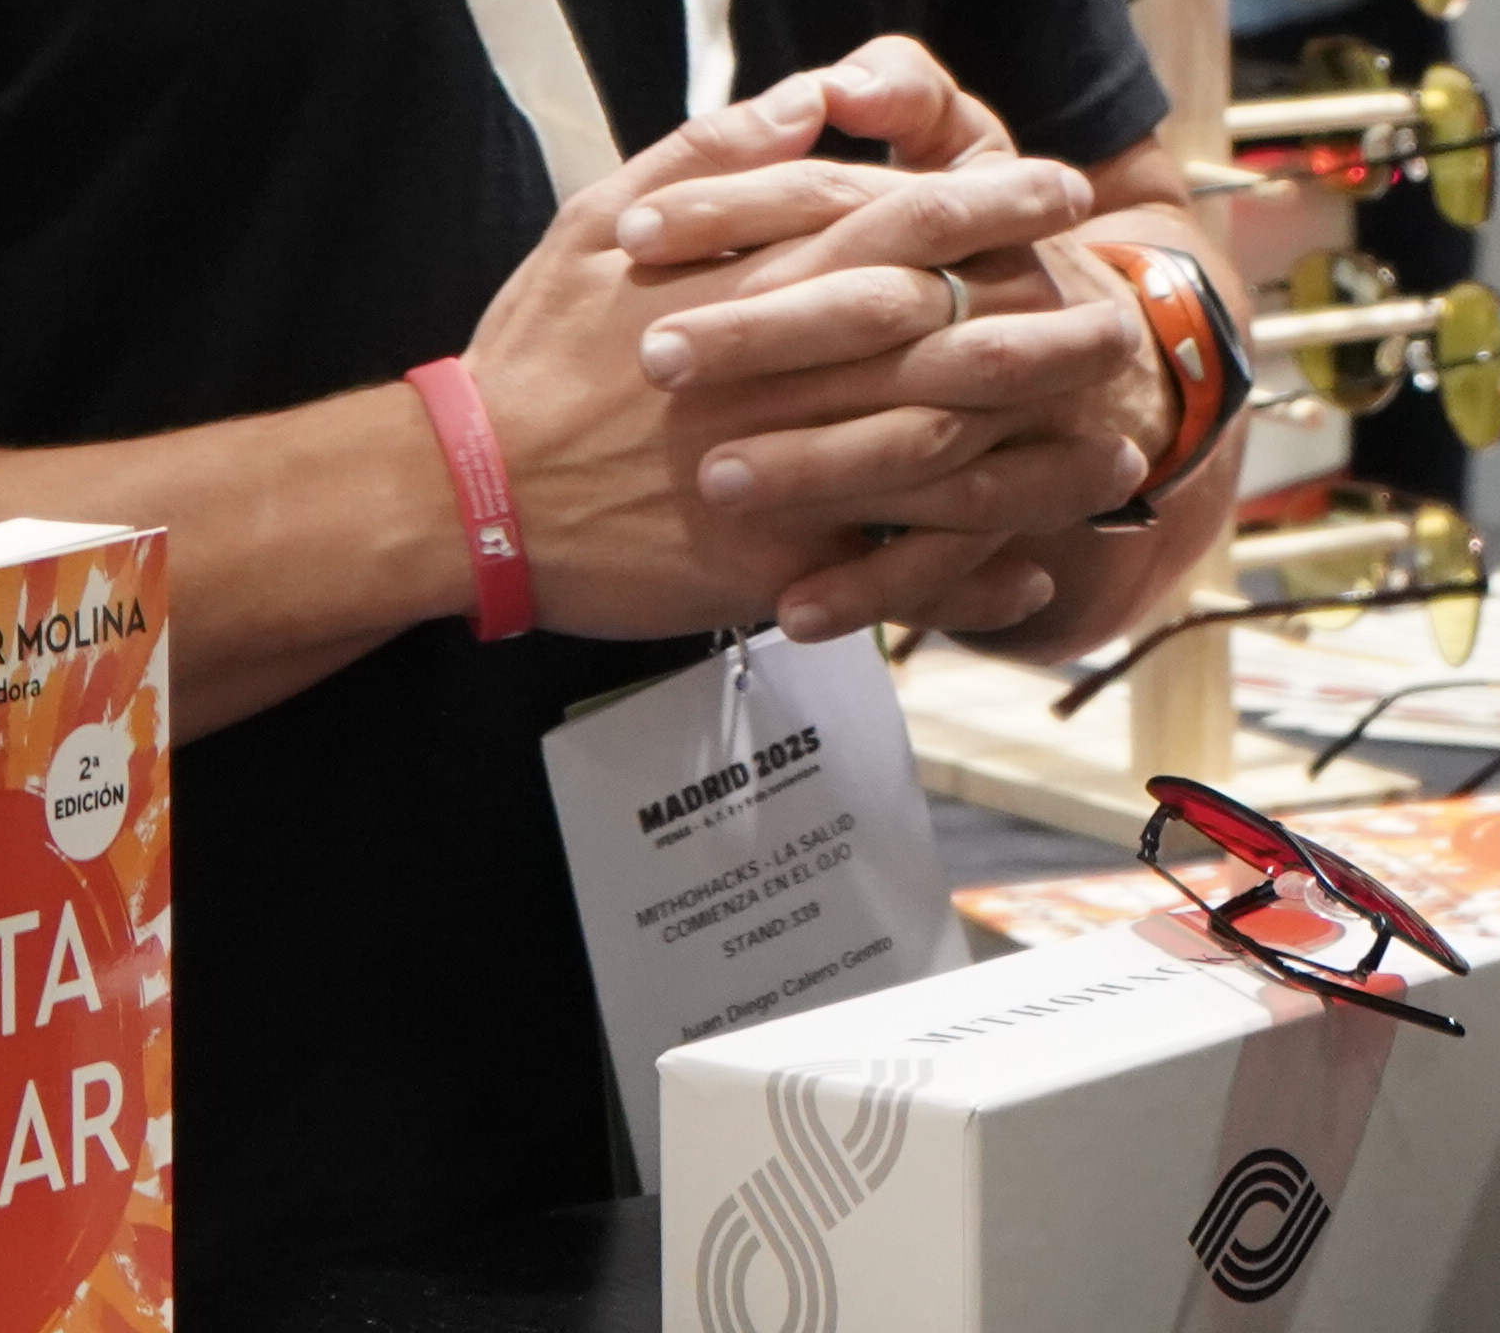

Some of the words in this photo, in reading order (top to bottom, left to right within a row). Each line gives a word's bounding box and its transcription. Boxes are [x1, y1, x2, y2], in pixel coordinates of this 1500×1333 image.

[16, 596, 148, 659] MOLINA
[78, 755, 102, 781] 2ª
[638, 762, 749, 834] MADRID
[753, 726, 820, 778] 2025
[54, 783, 126, 822] EDICIÓN
[773, 842, 798, 866] LA
[763, 873, 789, 898] EN
